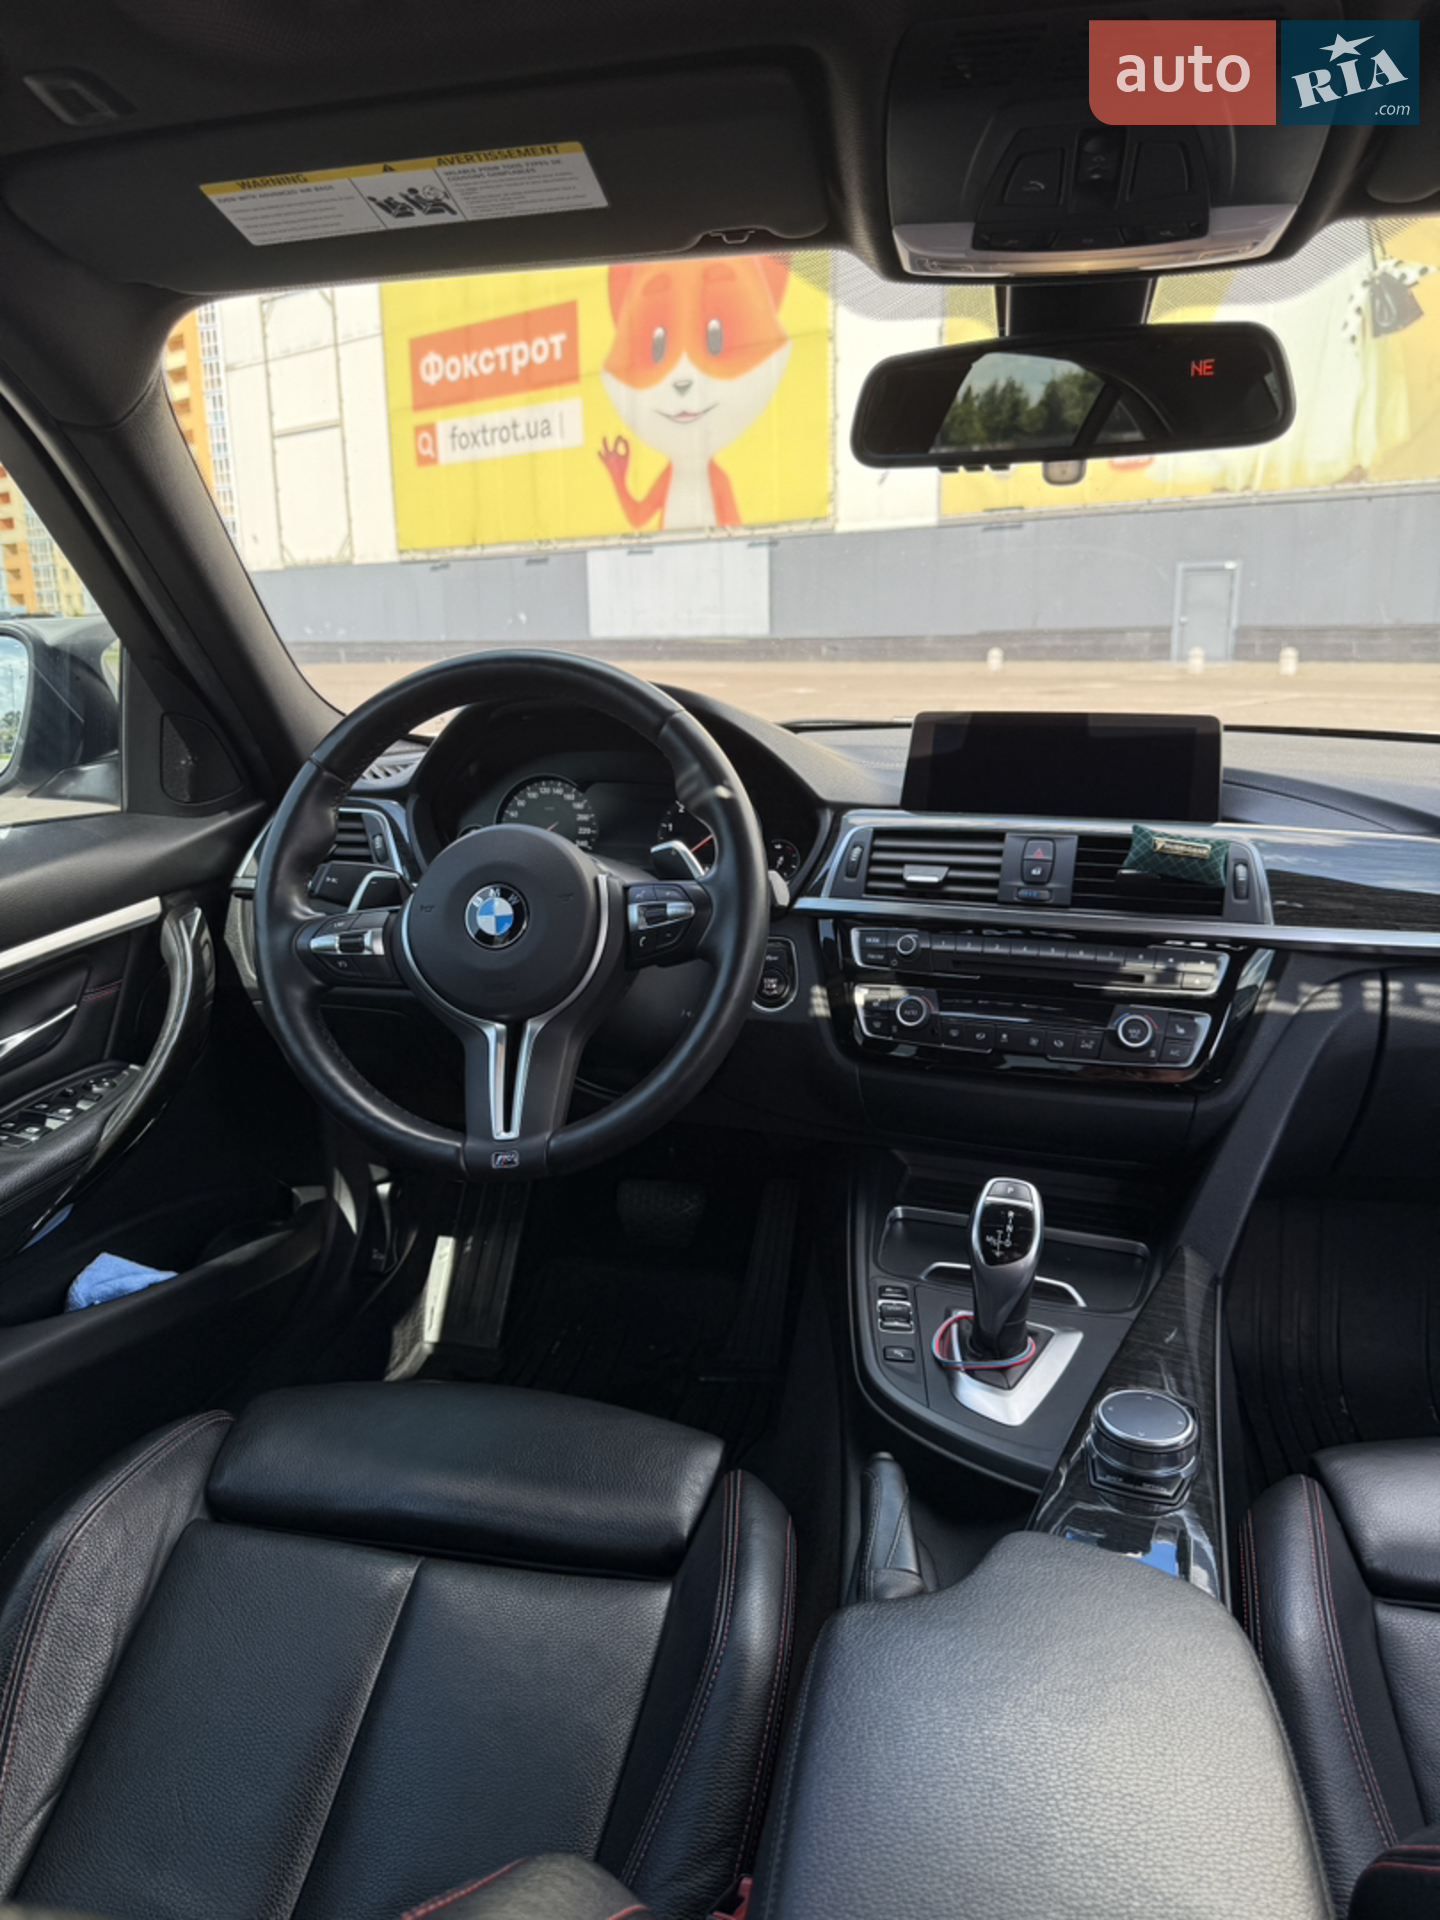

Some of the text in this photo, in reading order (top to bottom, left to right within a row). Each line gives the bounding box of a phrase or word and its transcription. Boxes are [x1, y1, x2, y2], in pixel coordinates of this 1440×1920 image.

[436, 145, 560, 167] AVERTISSEMENT
[236, 174, 309, 191] WARNING
[419, 332, 567, 387] Фокстрот
[1190, 358, 1216, 378] NE
[449, 418, 553, 453] foxtrot.ua
[471, 888, 521, 908] BMW
